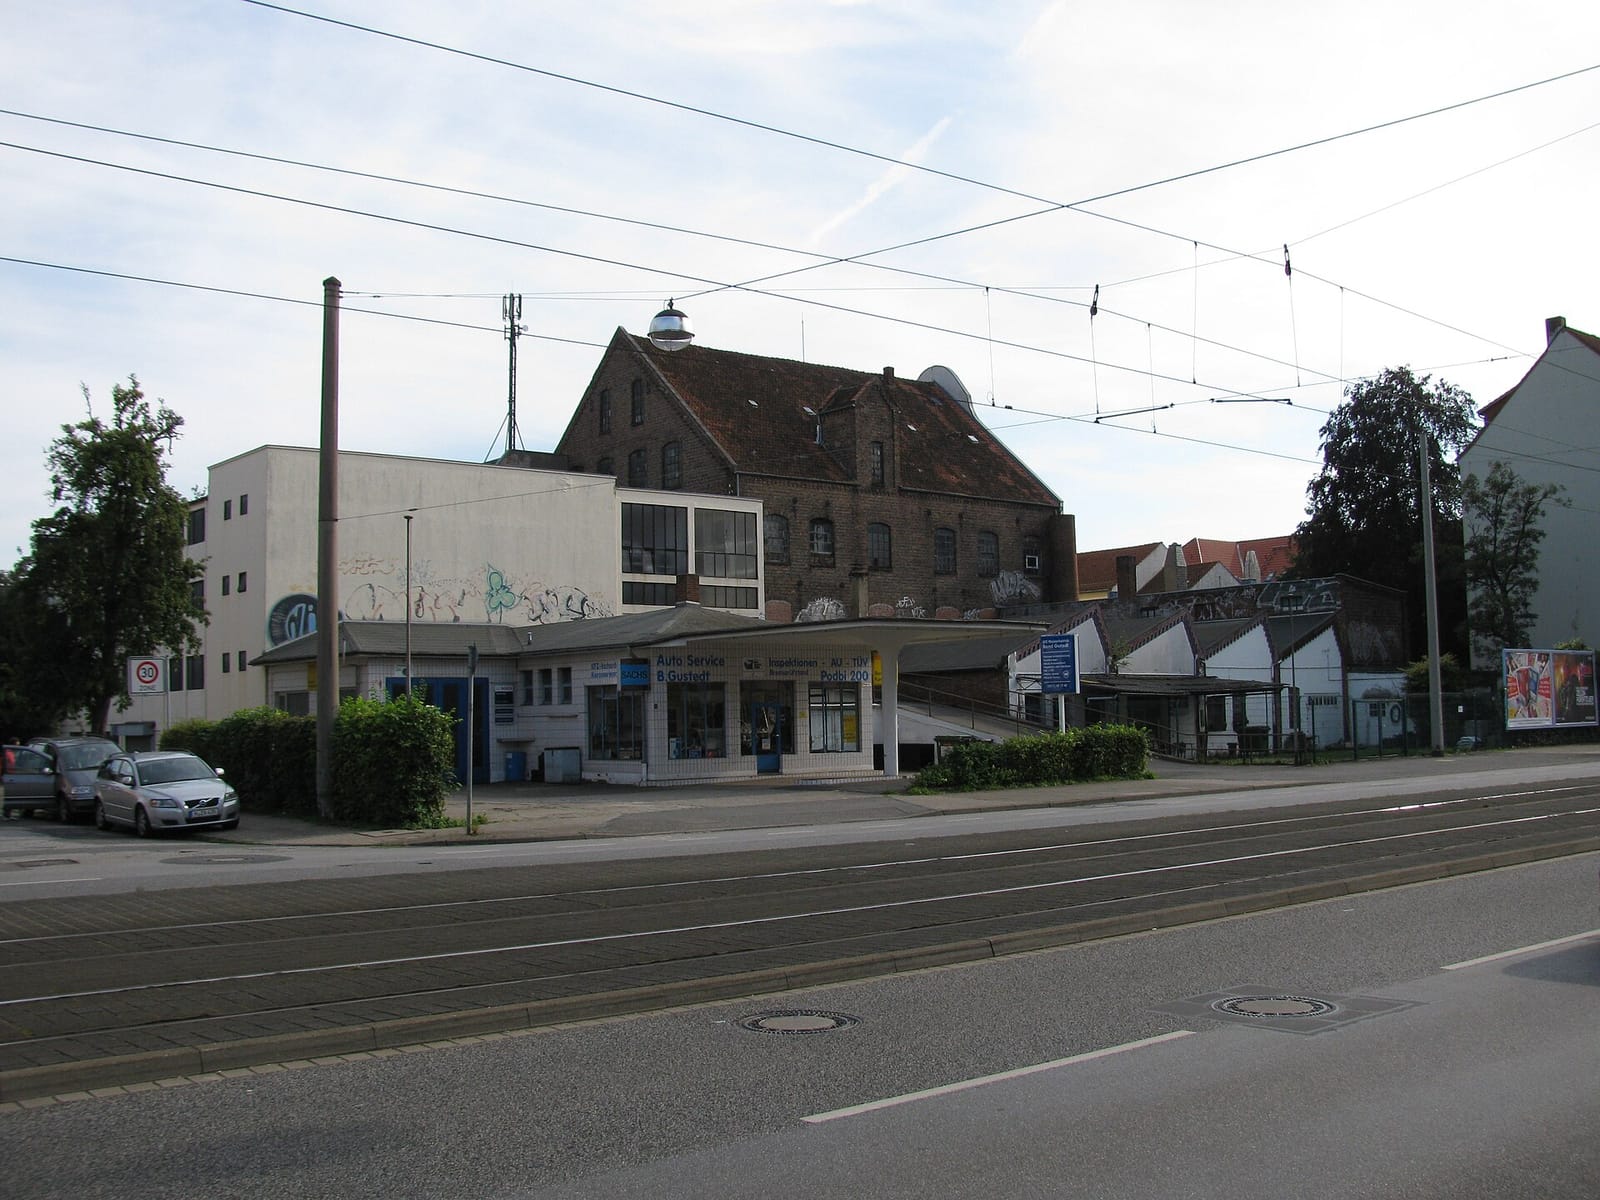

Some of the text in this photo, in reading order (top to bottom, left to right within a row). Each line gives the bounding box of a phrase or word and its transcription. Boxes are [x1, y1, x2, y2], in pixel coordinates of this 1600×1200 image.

[657, 654, 725, 666] Auto Service
[769, 656, 818, 668] Inspektionen
[830, 658, 842, 667] AU
[853, 656, 868, 667] TÜV
[141, 668, 154, 678] 30
[622, 670, 648, 680] SACHS
[820, 670, 847, 681] Podbi
[850, 670, 869, 681] 200
